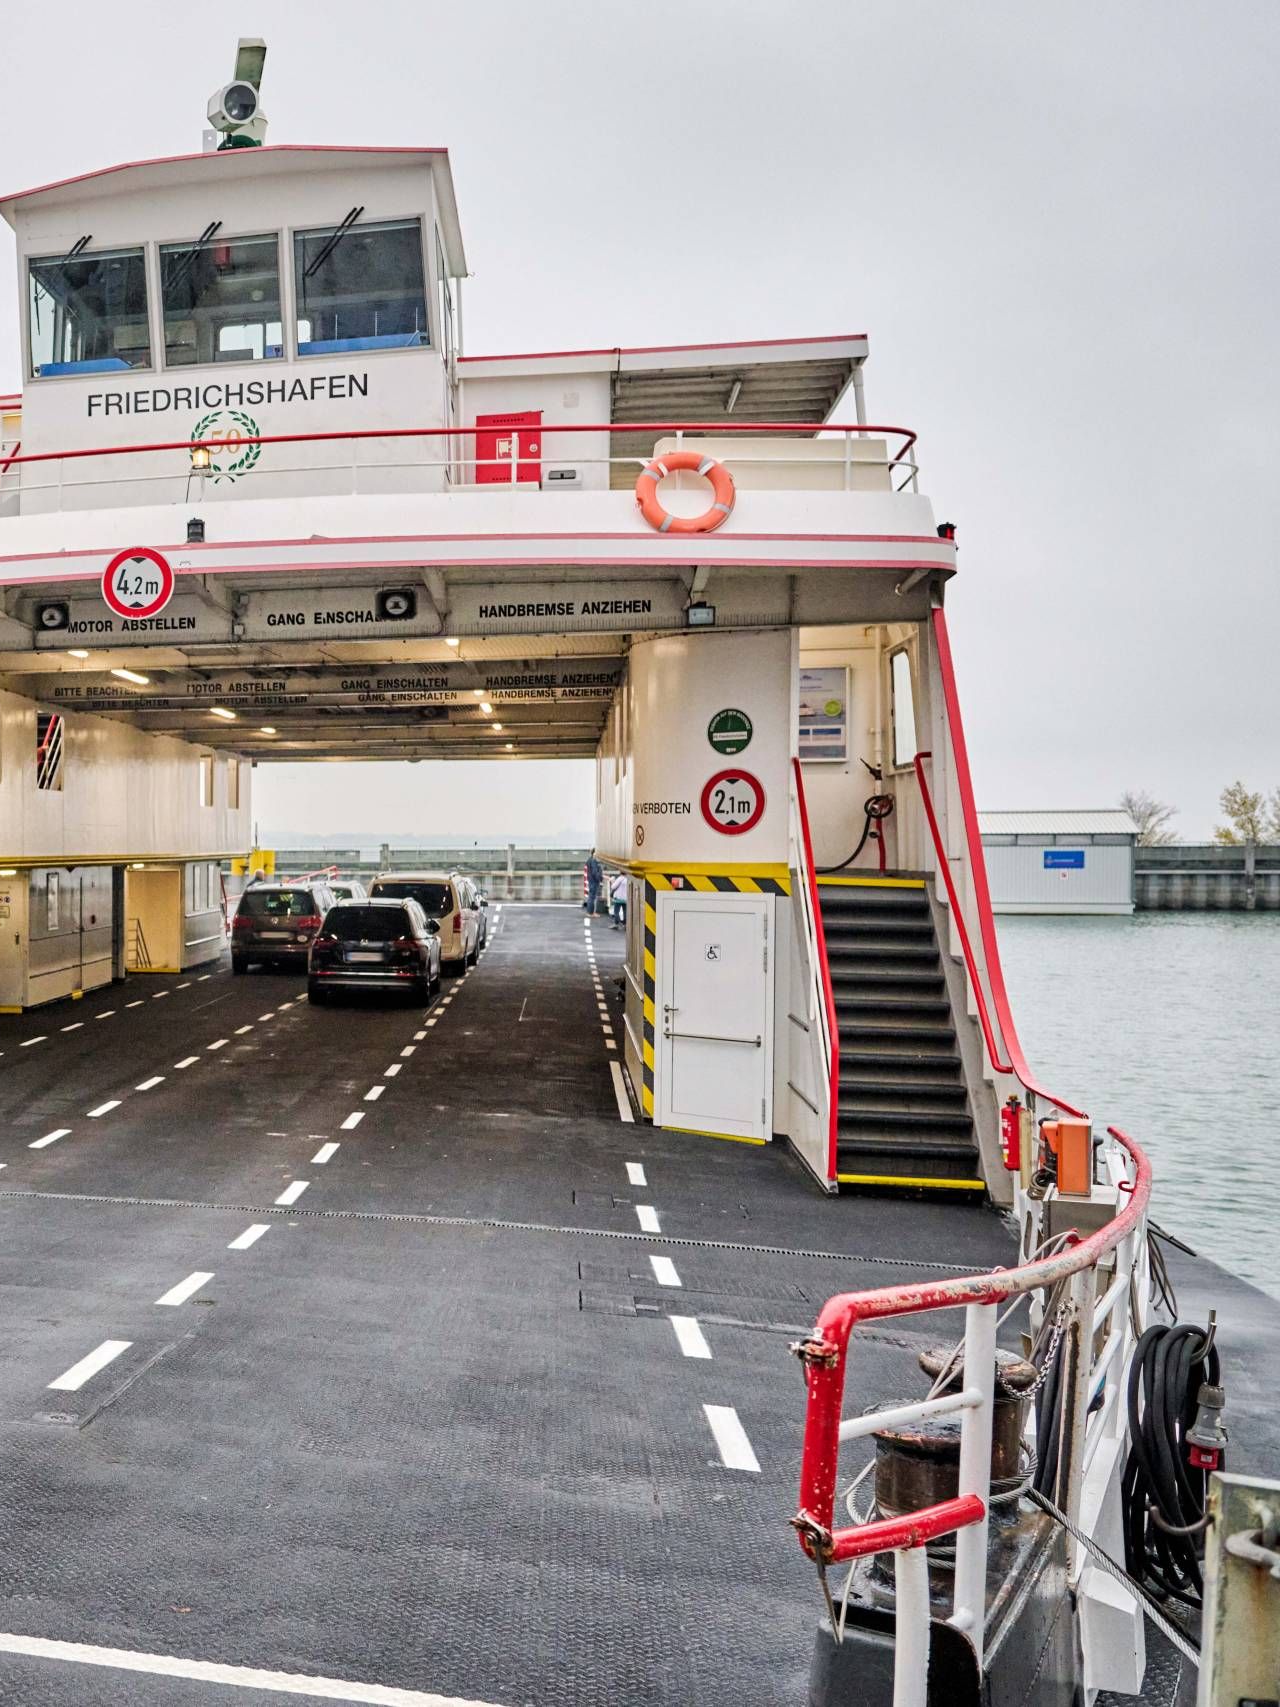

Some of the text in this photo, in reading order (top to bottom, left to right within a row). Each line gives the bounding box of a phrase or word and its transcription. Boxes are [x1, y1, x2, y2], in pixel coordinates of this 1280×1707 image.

[87, 373, 369, 417] FRIEDRICHSHAFEN
[211, 428, 241, 455] 50
[479, 599, 652, 618] HANDBREMSE ANZIEHEN
[67, 616, 196, 633] MOTOR ABSTELLEN
[267, 612, 306, 626] GANG
[341, 677, 449, 690] GANG EINSCHALTEN
[485, 674, 557, 687] HANDBREMSE
[54, 687, 82, 697] BITTE
[228, 682, 286, 693] ABSTELLEN
[490, 688, 557, 700] HANDBREMSE
[391, 691, 458, 702] EINSCHALTEN
[639, 802, 691, 814] VERBOTEN
